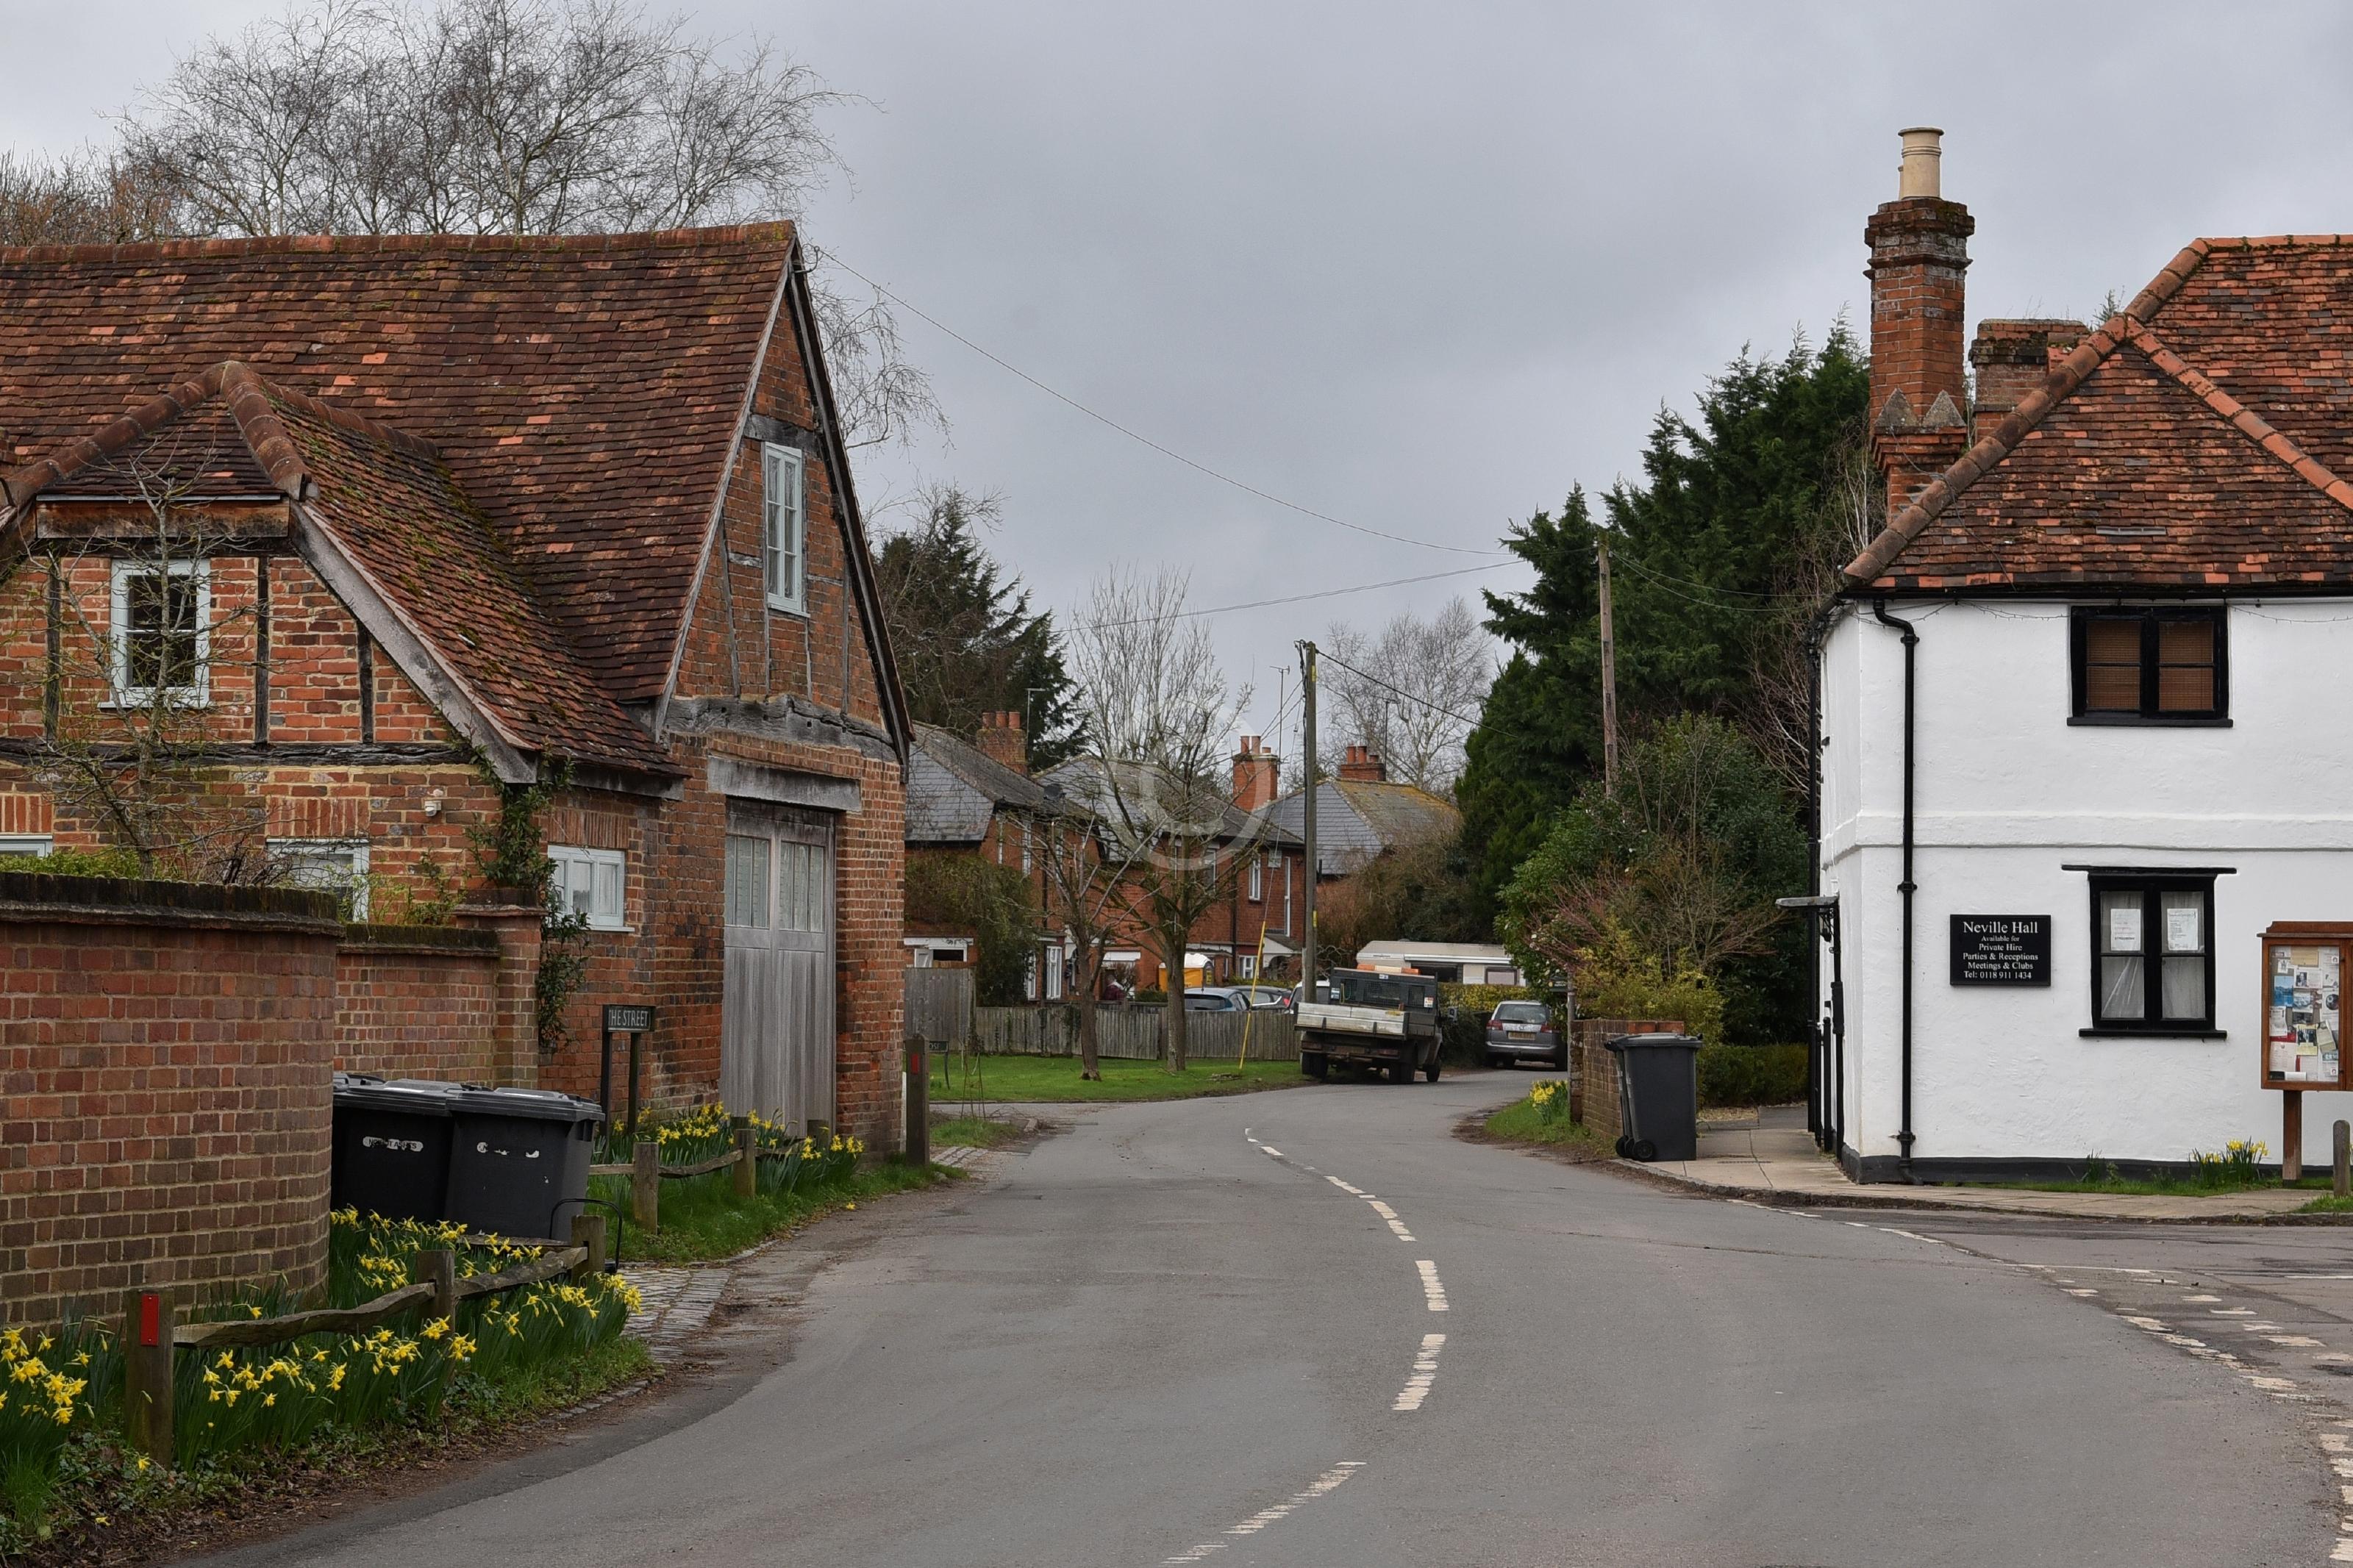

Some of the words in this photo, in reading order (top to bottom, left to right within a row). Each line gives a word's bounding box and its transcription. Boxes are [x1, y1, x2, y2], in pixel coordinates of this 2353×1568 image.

[1963, 921, 2008, 934] Neville
[2012, 921, 2038, 934] Hall
[1979, 943, 2004, 951] Private
[2006, 943, 2023, 951] Hire
[1963, 952, 1988, 960] Parties
[1999, 953, 2038, 962] Receptions
[1968, 962, 2001, 970] Meetings
[2002, 962, 2010, 970] &
[2012, 962, 2034, 970] Clubs
[1963, 970, 1978, 979] Tel:
[1979, 971, 1998, 979] 0118
[1999, 971, 2011, 979] 911
[2015, 971, 2032, 979] 1434
[623, 1011, 648, 1026] STREET
